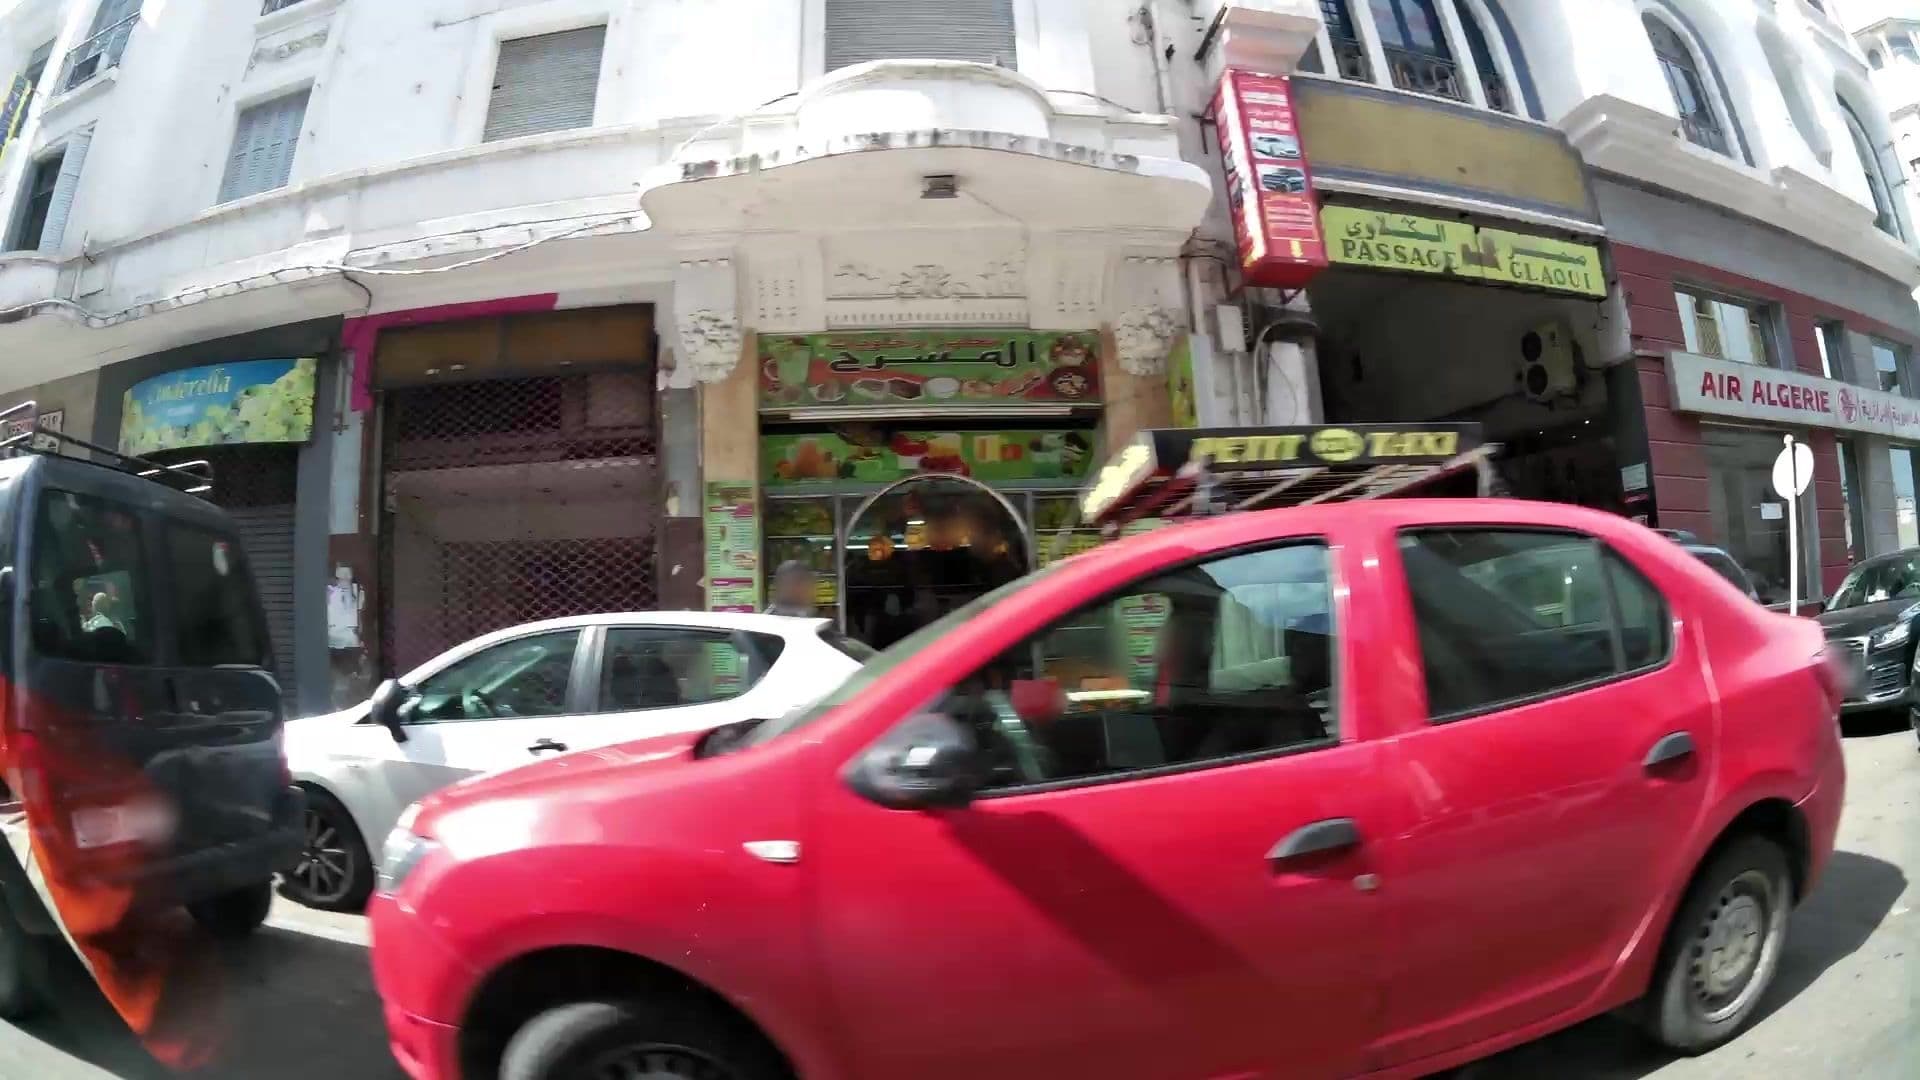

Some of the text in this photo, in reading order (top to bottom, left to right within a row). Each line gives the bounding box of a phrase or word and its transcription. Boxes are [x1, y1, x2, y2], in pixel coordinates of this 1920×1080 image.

[1340, 239, 1593, 290] PASSAGE GLAOUI
[829, 340, 1036, 373] المسرح
[1701, 370, 1831, 414] AIR ALGERIE
